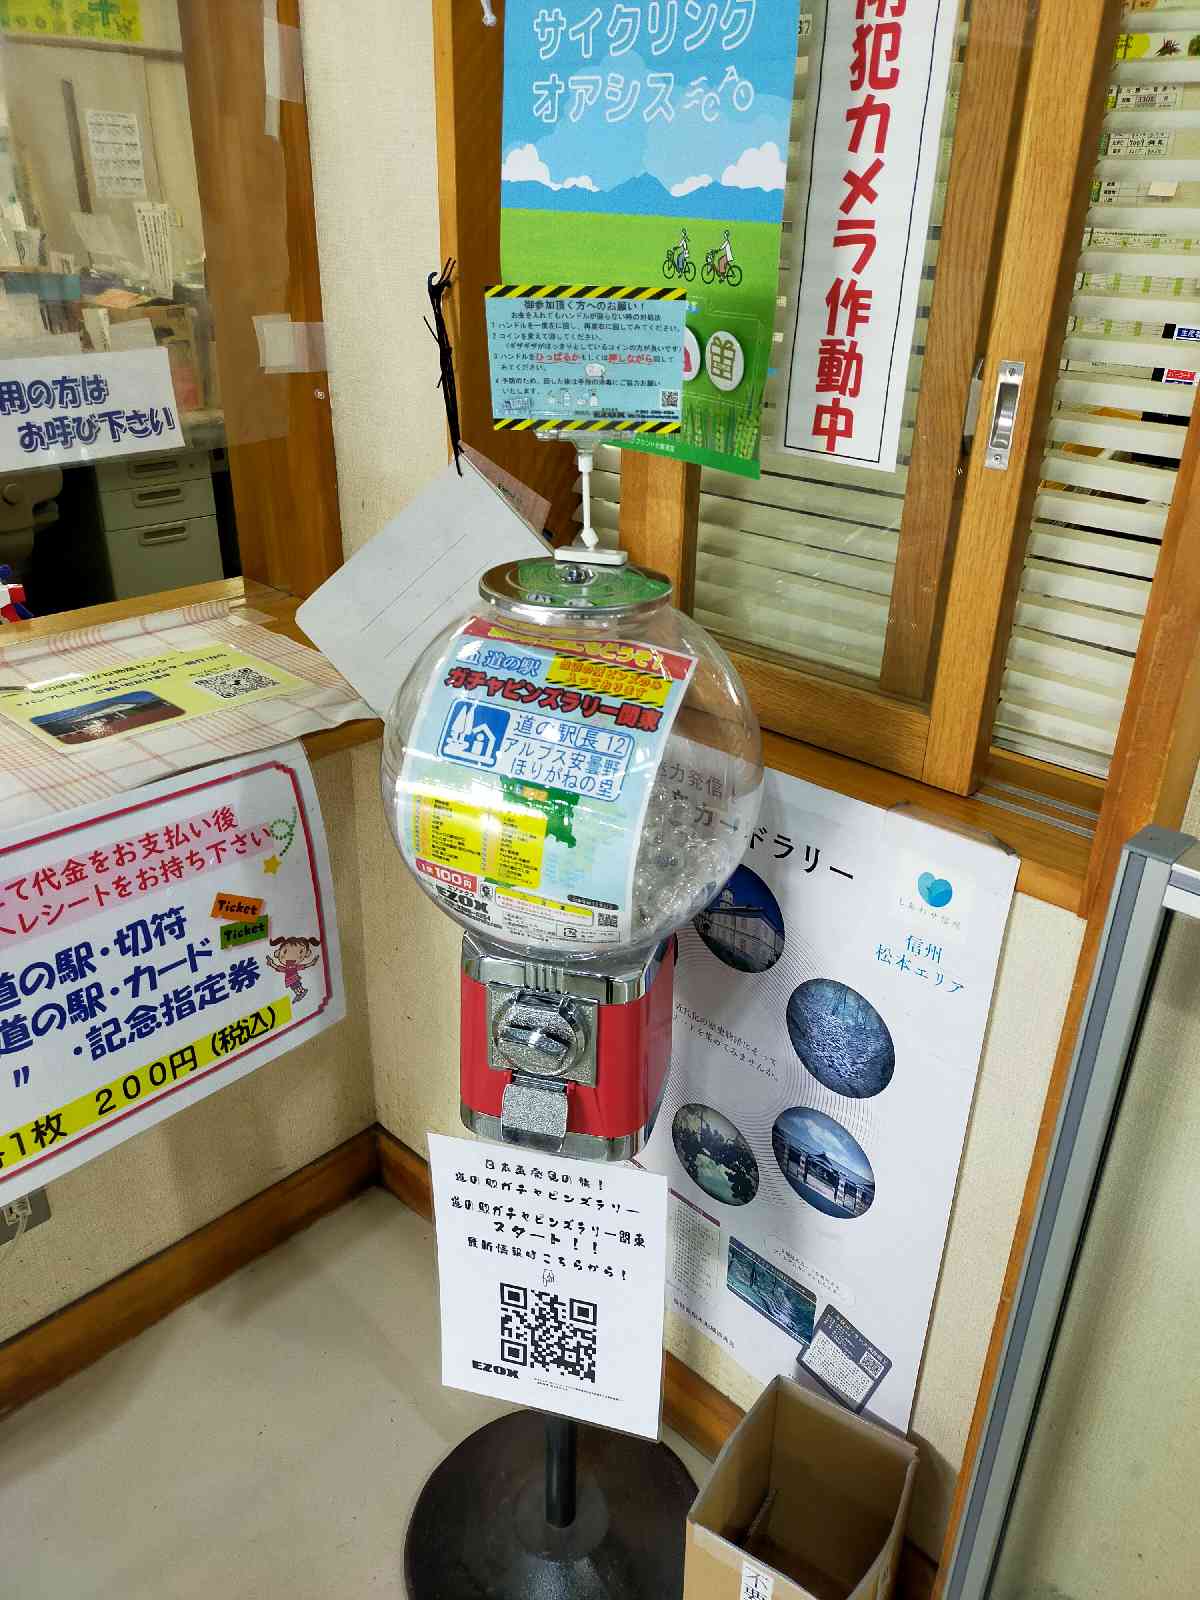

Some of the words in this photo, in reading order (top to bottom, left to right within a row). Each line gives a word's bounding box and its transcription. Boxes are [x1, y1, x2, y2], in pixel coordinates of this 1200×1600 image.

[532, 0, 757, 61] サイクリング
[532, 72, 675, 124] オアシス
[812, 0, 908, 453] 犯カメラ作動中
[0, 374, 109, 415] 用の方は
[17, 407, 175, 452] お呼び下さい
[482, 650, 542, 678] 道の駅
[444, 667, 664, 732] ガチャピンズラリー関東
[217, 899, 259, 915] Ticket
[223, 923, 266, 942] Ticket
[905, 935, 944, 965] 信州
[875, 943, 965, 993] 松本エリア
[0, 937, 213, 1055] 道の駅・カード
[0, 1112, 68, 1168] 1枚
[455, 1171, 640, 1214] 道の駅ガチャピンズラリー
[450, 1196, 646, 1248] 道の駅ガチャピンズラリー関東
[471, 1359, 520, 1380] EZOX
